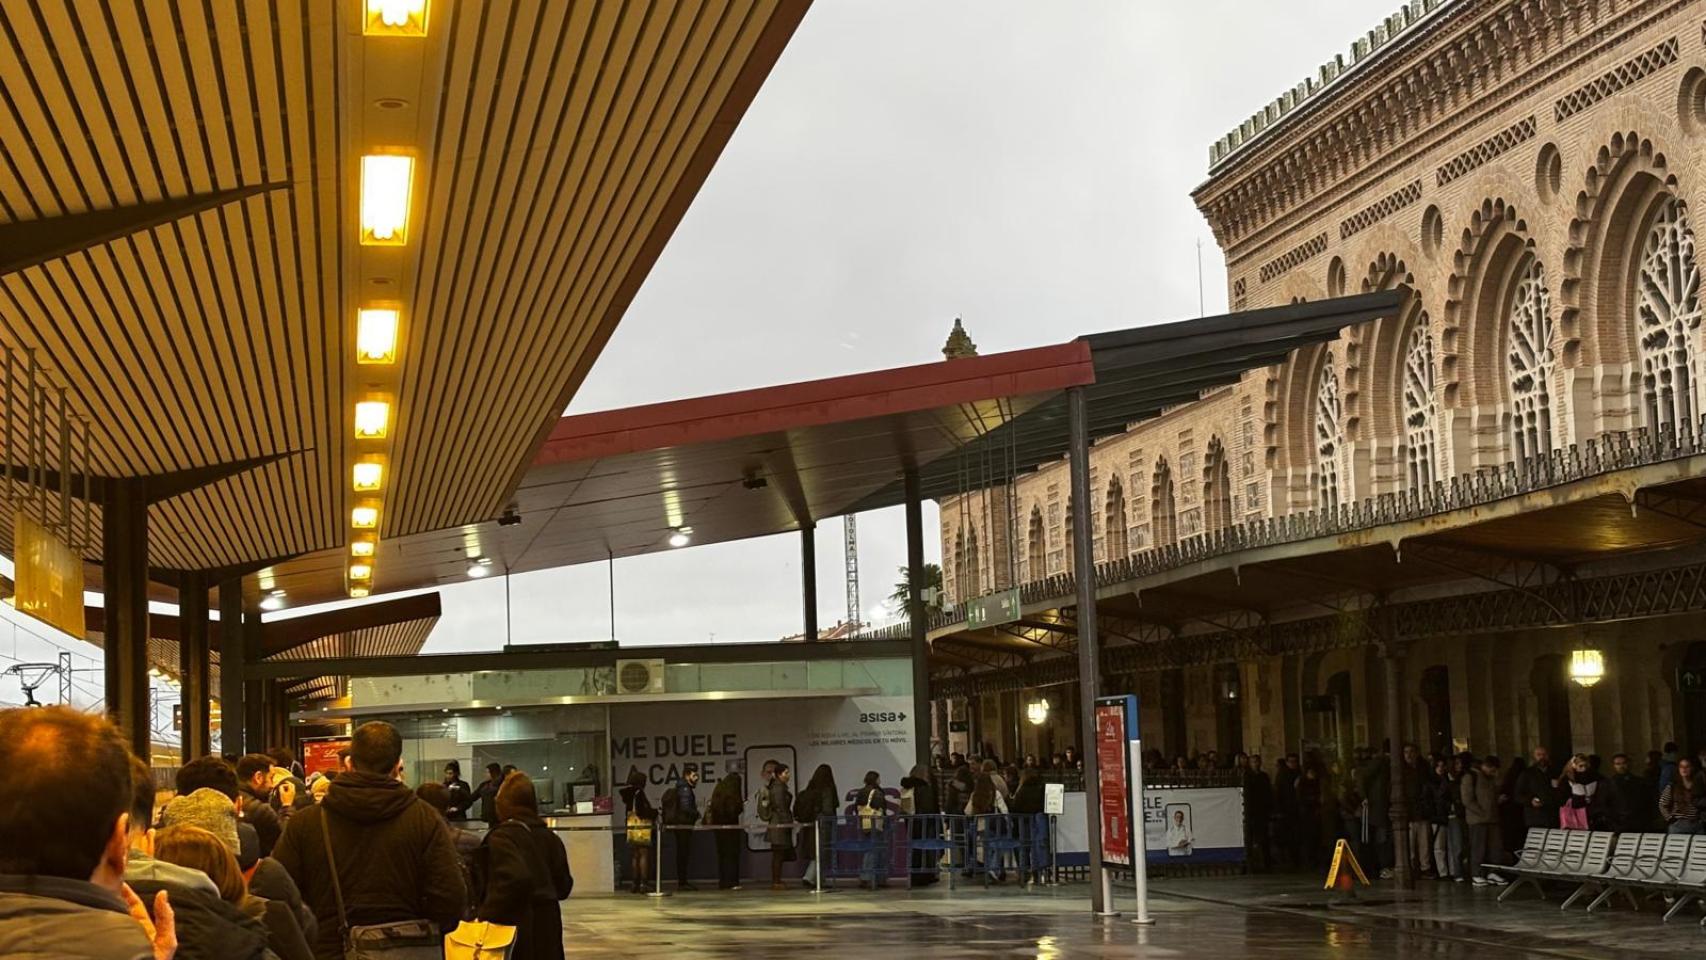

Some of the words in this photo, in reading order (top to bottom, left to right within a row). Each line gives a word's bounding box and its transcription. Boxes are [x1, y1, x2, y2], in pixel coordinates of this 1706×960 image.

[860, 712, 896, 723] asisa
[611, 736, 648, 759] ME
[655, 734, 737, 758] DUELE
